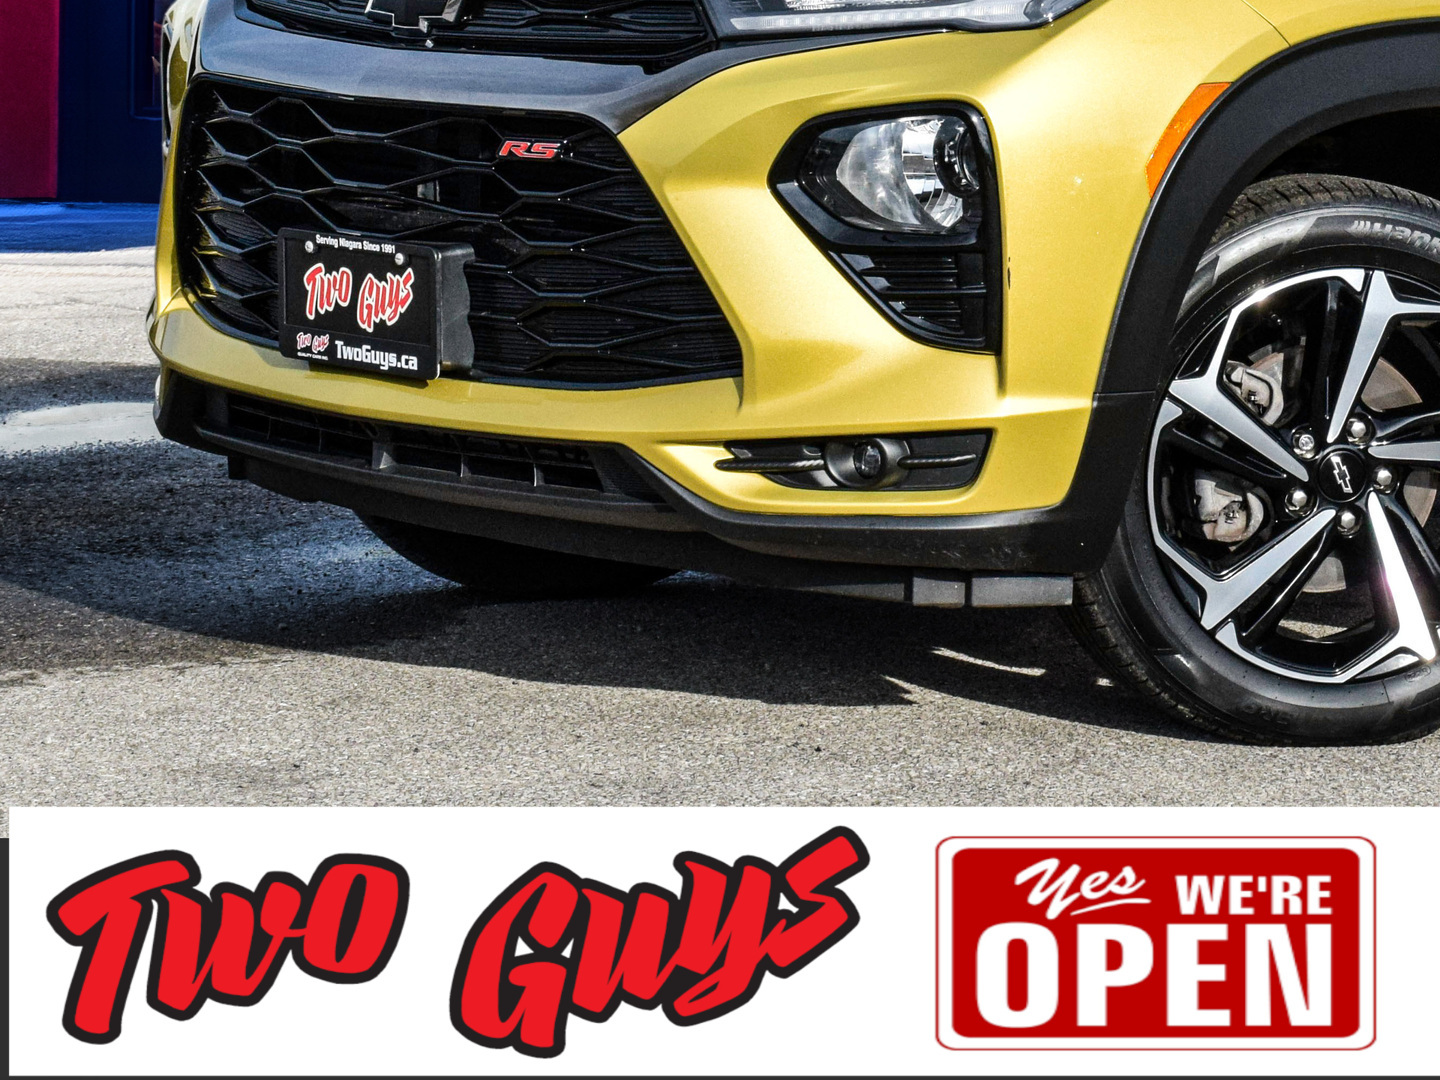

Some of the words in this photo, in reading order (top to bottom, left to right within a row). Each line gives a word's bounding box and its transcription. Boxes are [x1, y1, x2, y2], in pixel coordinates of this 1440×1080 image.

[499, 140, 561, 159] RS
[315, 234, 339, 248] Serving
[339, 237, 362, 250] Niagara
[363, 240, 380, 252] Since
[381, 243, 396, 254] 1991
[334, 340, 418, 371] TwoGuys.ca
